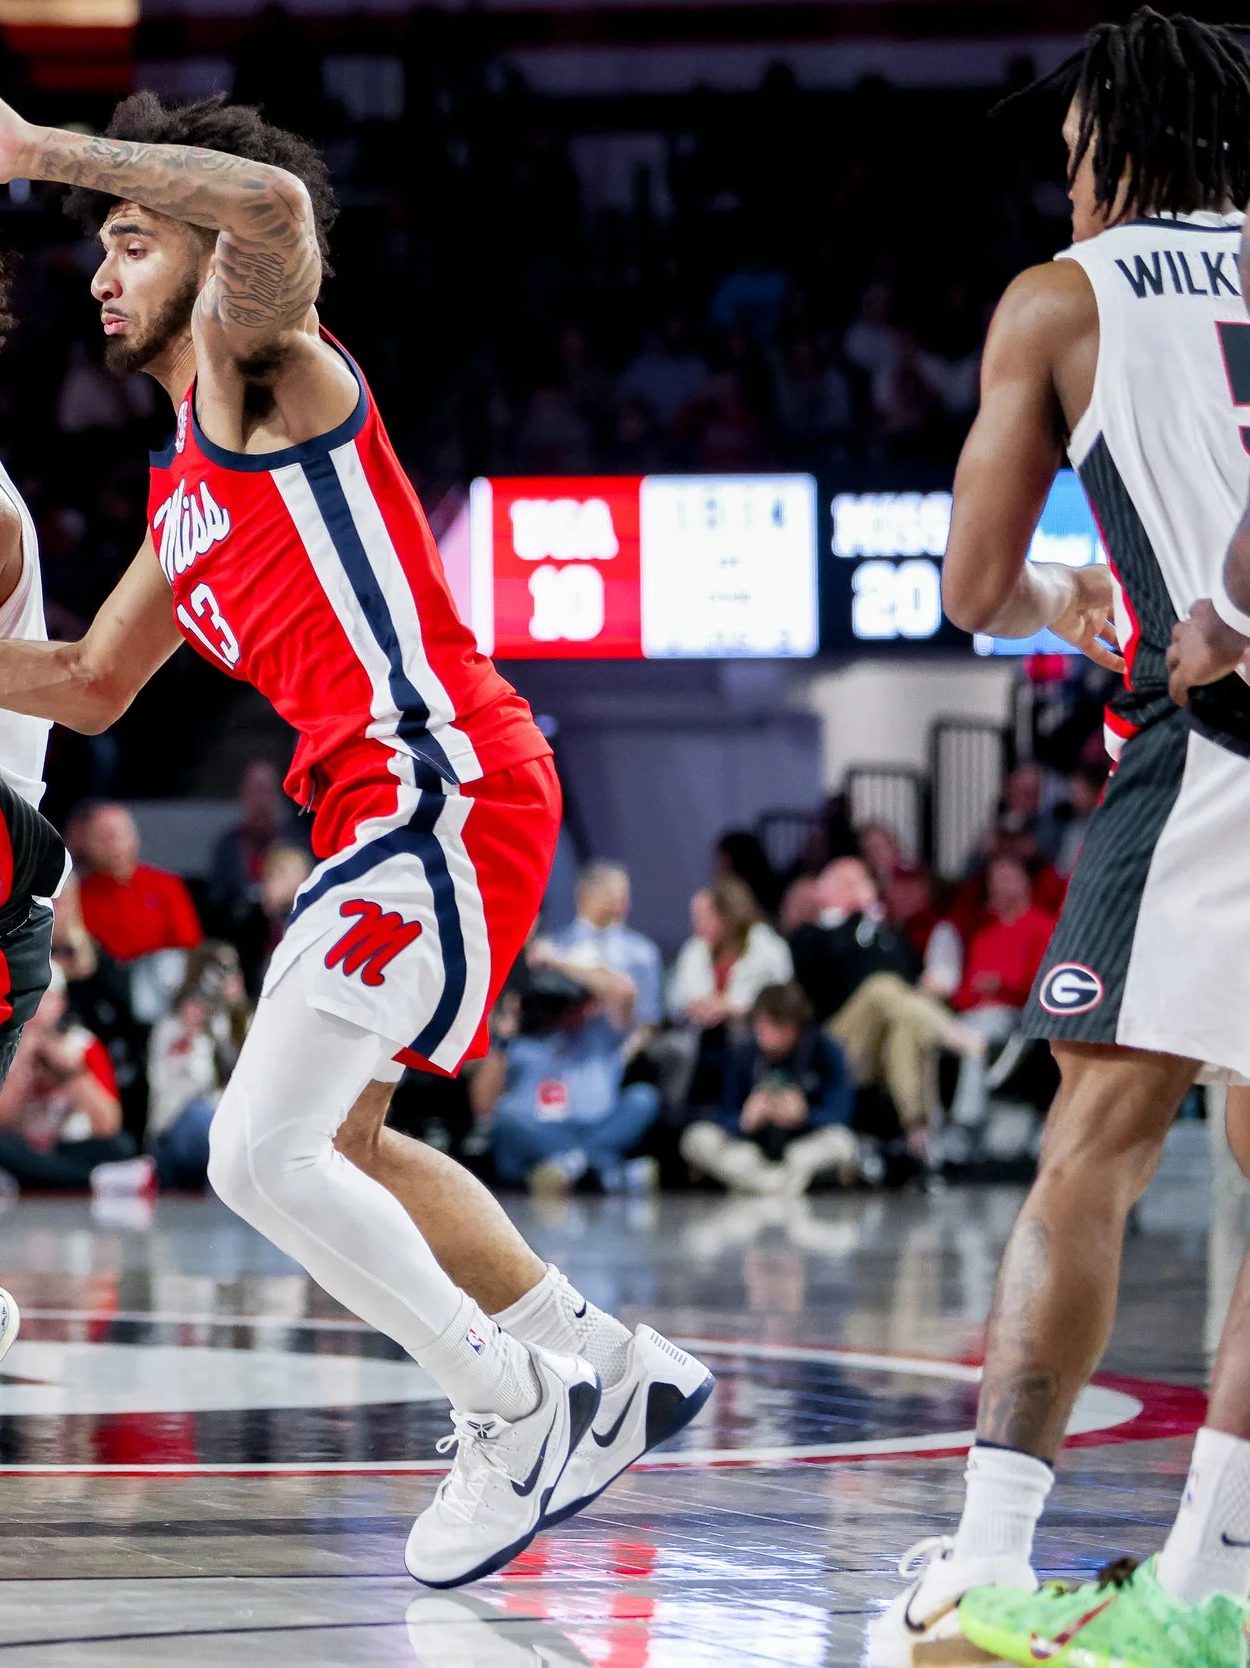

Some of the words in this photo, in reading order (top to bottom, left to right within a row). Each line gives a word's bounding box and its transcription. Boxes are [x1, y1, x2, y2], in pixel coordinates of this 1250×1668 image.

[1114, 250, 1242, 299] WILK
[153, 477, 232, 584] Miss
[175, 582, 241, 672] 13
[851, 559, 943, 640] 20
